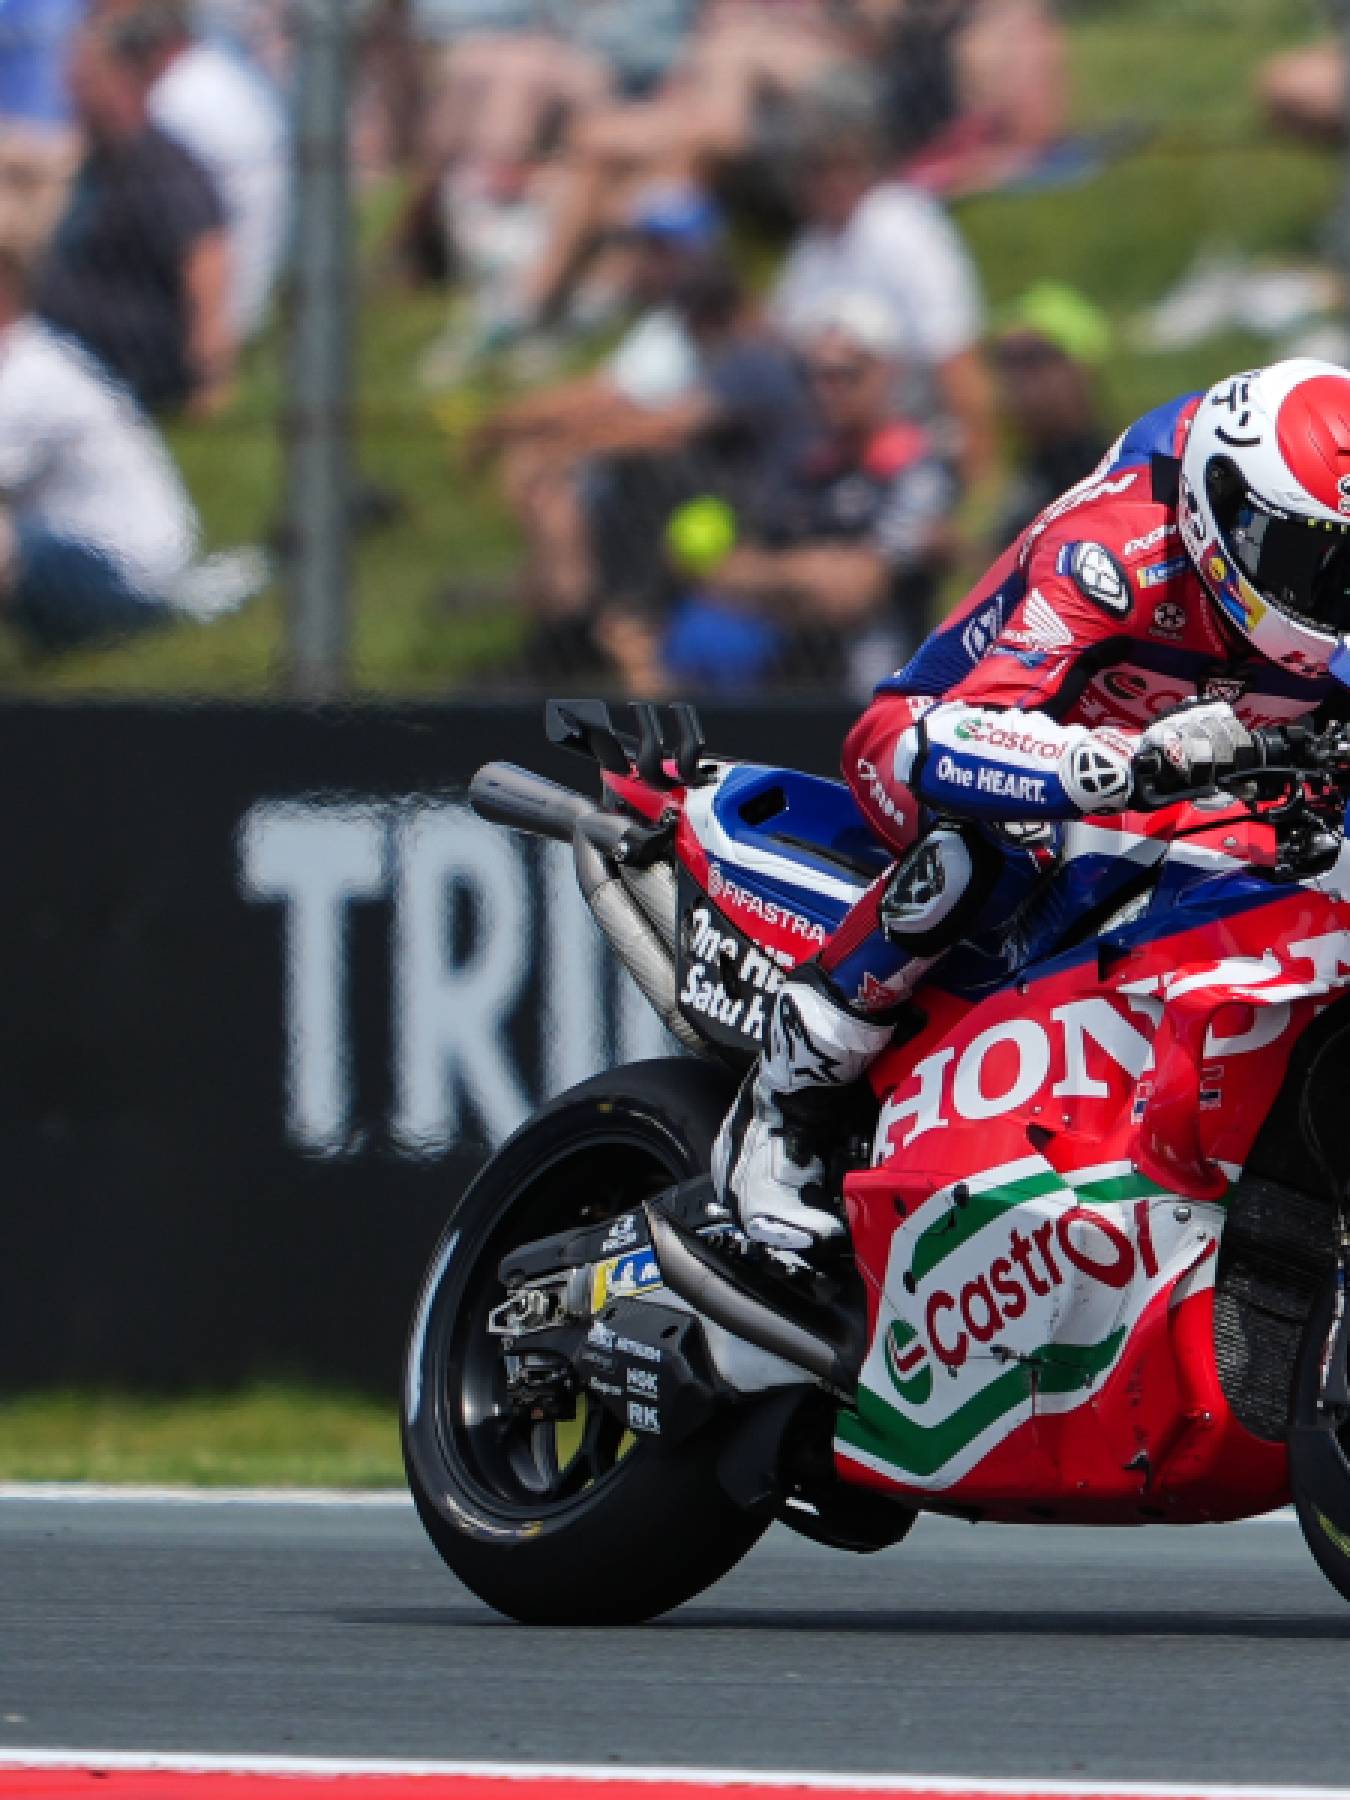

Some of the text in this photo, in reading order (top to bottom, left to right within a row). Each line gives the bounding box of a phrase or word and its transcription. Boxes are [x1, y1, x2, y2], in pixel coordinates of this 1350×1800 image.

[970, 722, 1069, 761] Castrol
[936, 755, 1048, 805] One HEART.
[722, 881, 827, 946] FIFASTRA
[925, 1200, 1160, 1367] Castrol
